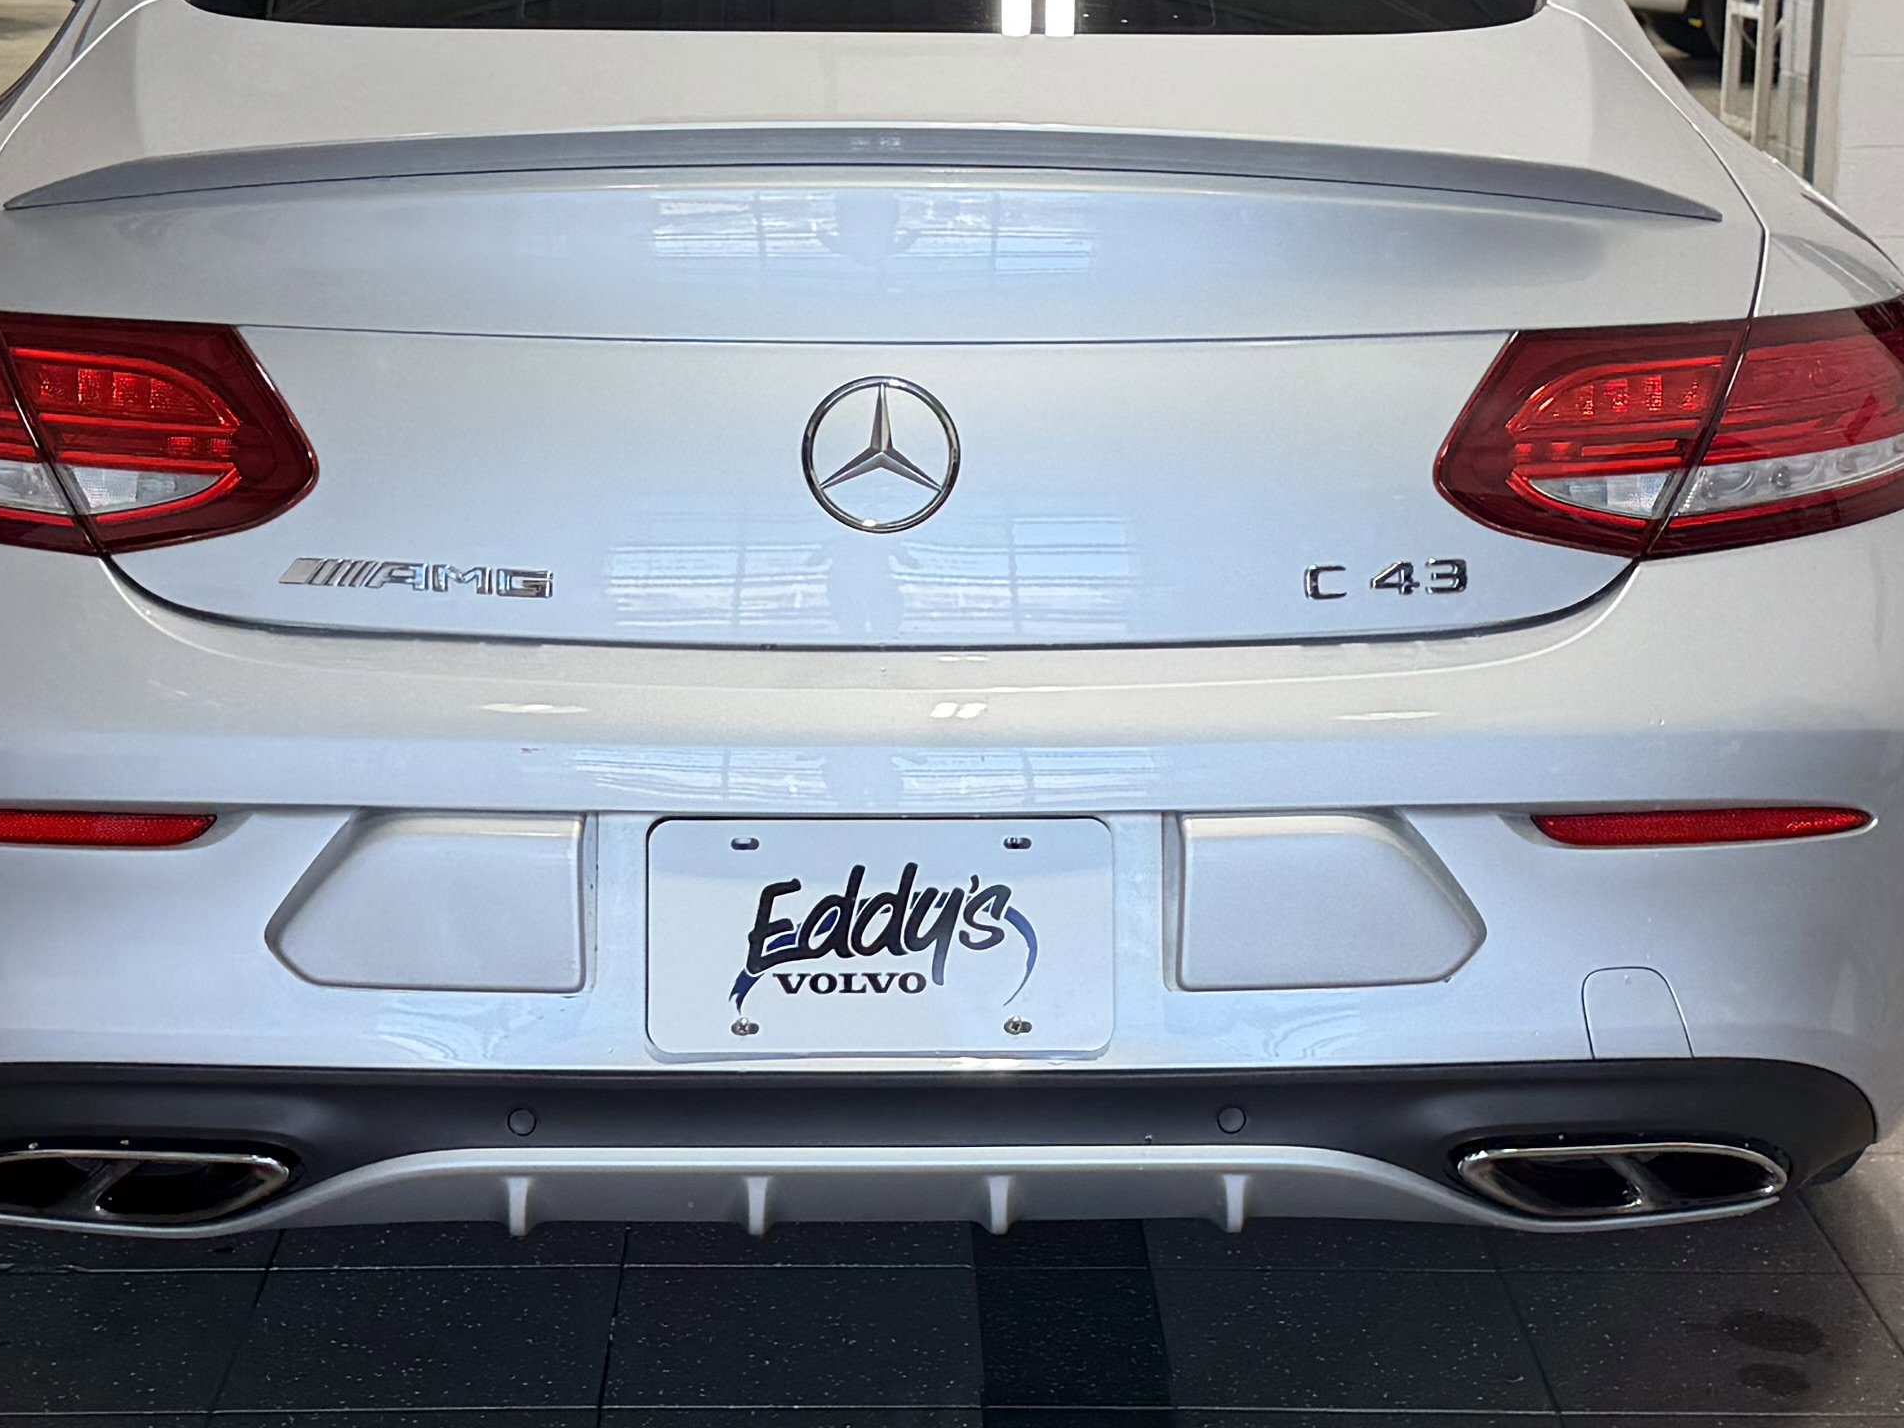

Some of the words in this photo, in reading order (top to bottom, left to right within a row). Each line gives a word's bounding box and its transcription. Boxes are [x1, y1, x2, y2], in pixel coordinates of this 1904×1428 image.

[364, 560, 553, 599] AMG
[1304, 564, 1347, 600] C
[1369, 557, 1468, 595] 43
[746, 862, 1013, 987] Eddy's
[773, 972, 927, 995] VOLVO
